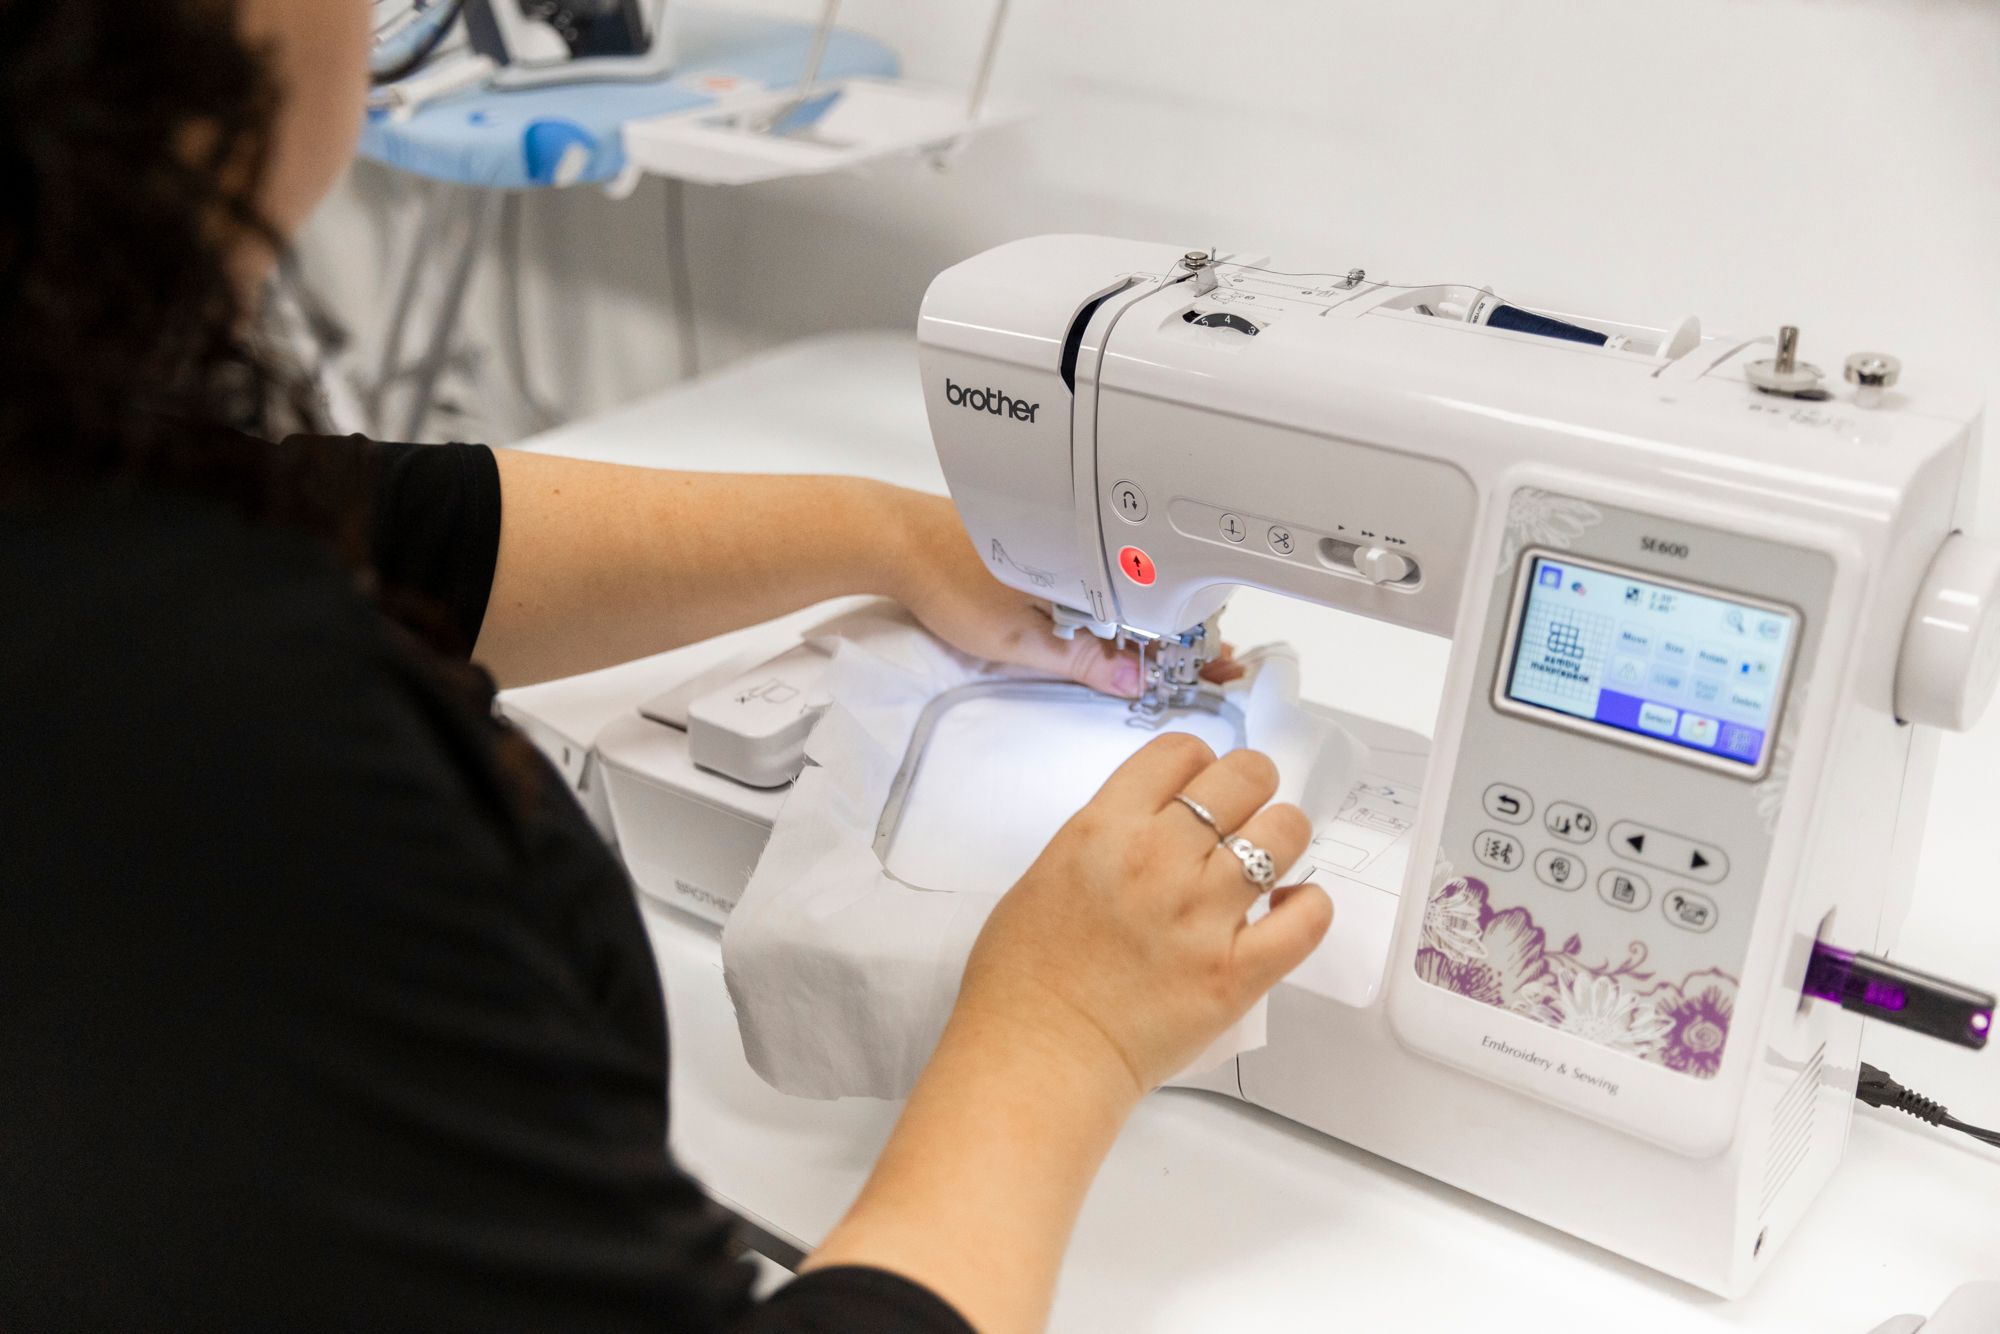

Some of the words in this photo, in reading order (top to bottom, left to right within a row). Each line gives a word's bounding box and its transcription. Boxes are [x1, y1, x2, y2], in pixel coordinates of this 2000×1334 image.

[1201, 318, 1209, 327] 5
[1224, 314, 1231, 324] 4
[1248, 326, 1256, 336] 3
[945, 377, 1040, 424] brother
[1641, 535, 1690, 559] SE600
[1621, 631, 1648, 645] Move
[1663, 641, 1685, 654] Size
[1698, 650, 1728, 665] Rotate
[1644, 710, 1672, 726] Select
[1481, 1035, 1553, 1072] Embroidery
[1557, 1063, 1568, 1075] &
[1573, 1066, 1620, 1096] Sewing
